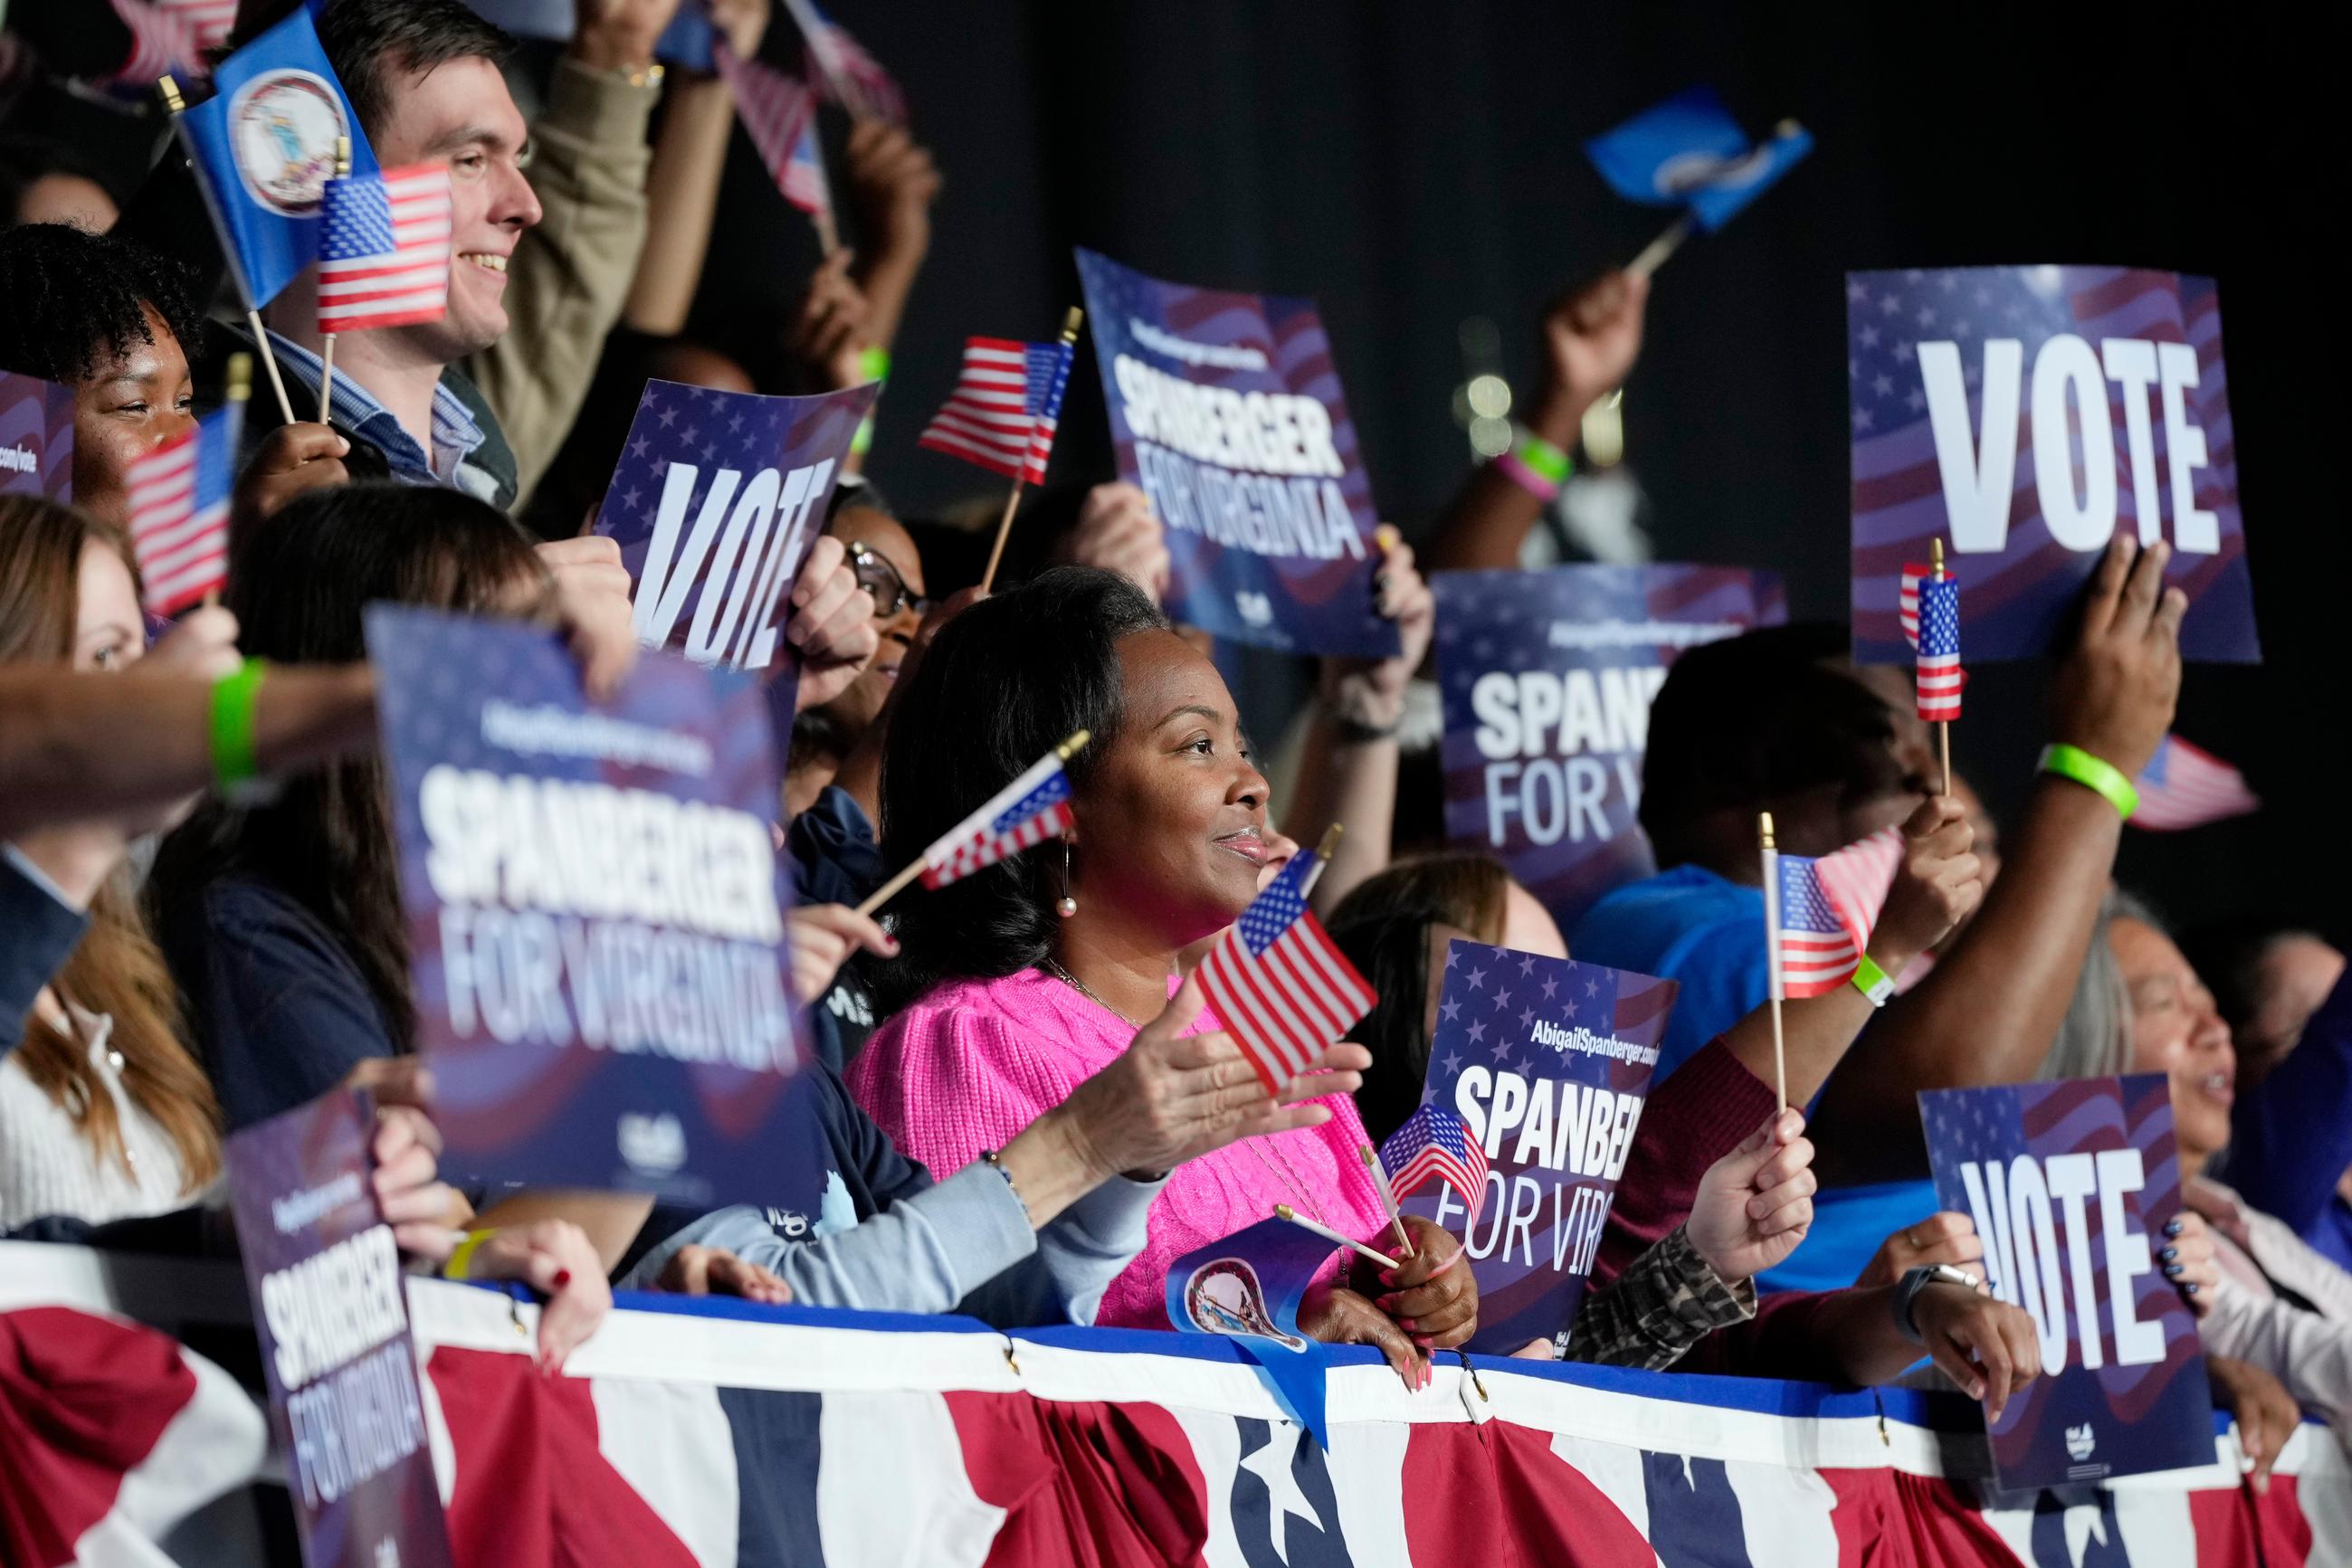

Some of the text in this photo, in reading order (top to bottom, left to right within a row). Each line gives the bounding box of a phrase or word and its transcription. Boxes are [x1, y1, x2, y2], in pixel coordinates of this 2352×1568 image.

[1114, 353, 1346, 478] SPANBERGER
[1917, 333, 2220, 555] VOTE
[633, 457, 835, 673] VOTE
[1189, 452, 1366, 561] VIRGINIA
[419, 764, 784, 947] SPANBERGER
[1484, 757, 1614, 847] FOR
[439, 905, 798, 1077] FOR VIRGINIA
[1960, 1148, 2166, 1377] VOTE
